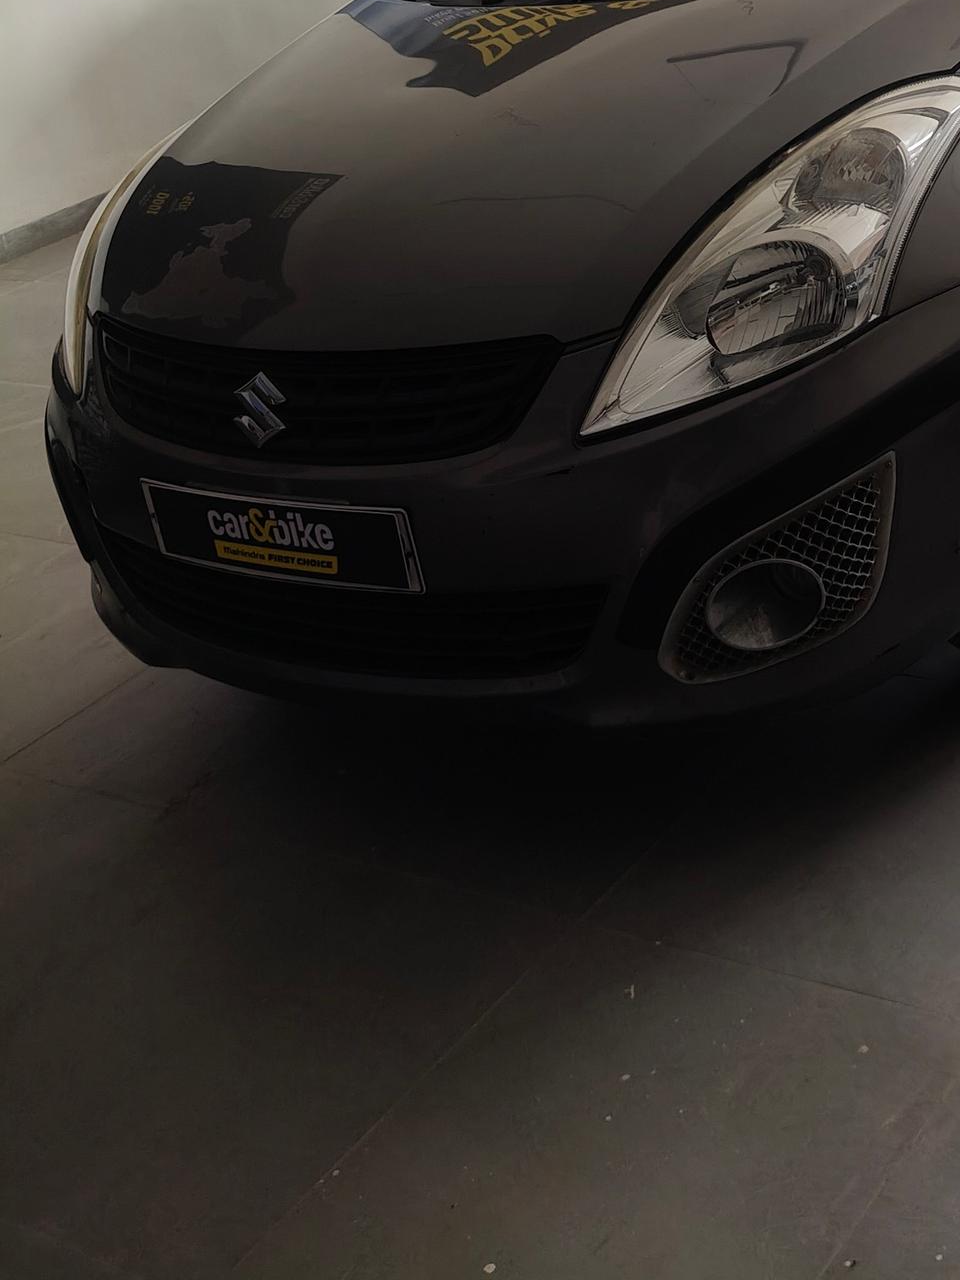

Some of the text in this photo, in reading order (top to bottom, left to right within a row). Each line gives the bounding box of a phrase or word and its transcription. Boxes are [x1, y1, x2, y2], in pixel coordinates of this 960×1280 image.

[207, 507, 335, 551] car&bike
[267, 553, 296, 565] FIRST
[296, 556, 333, 569] CHOICE
